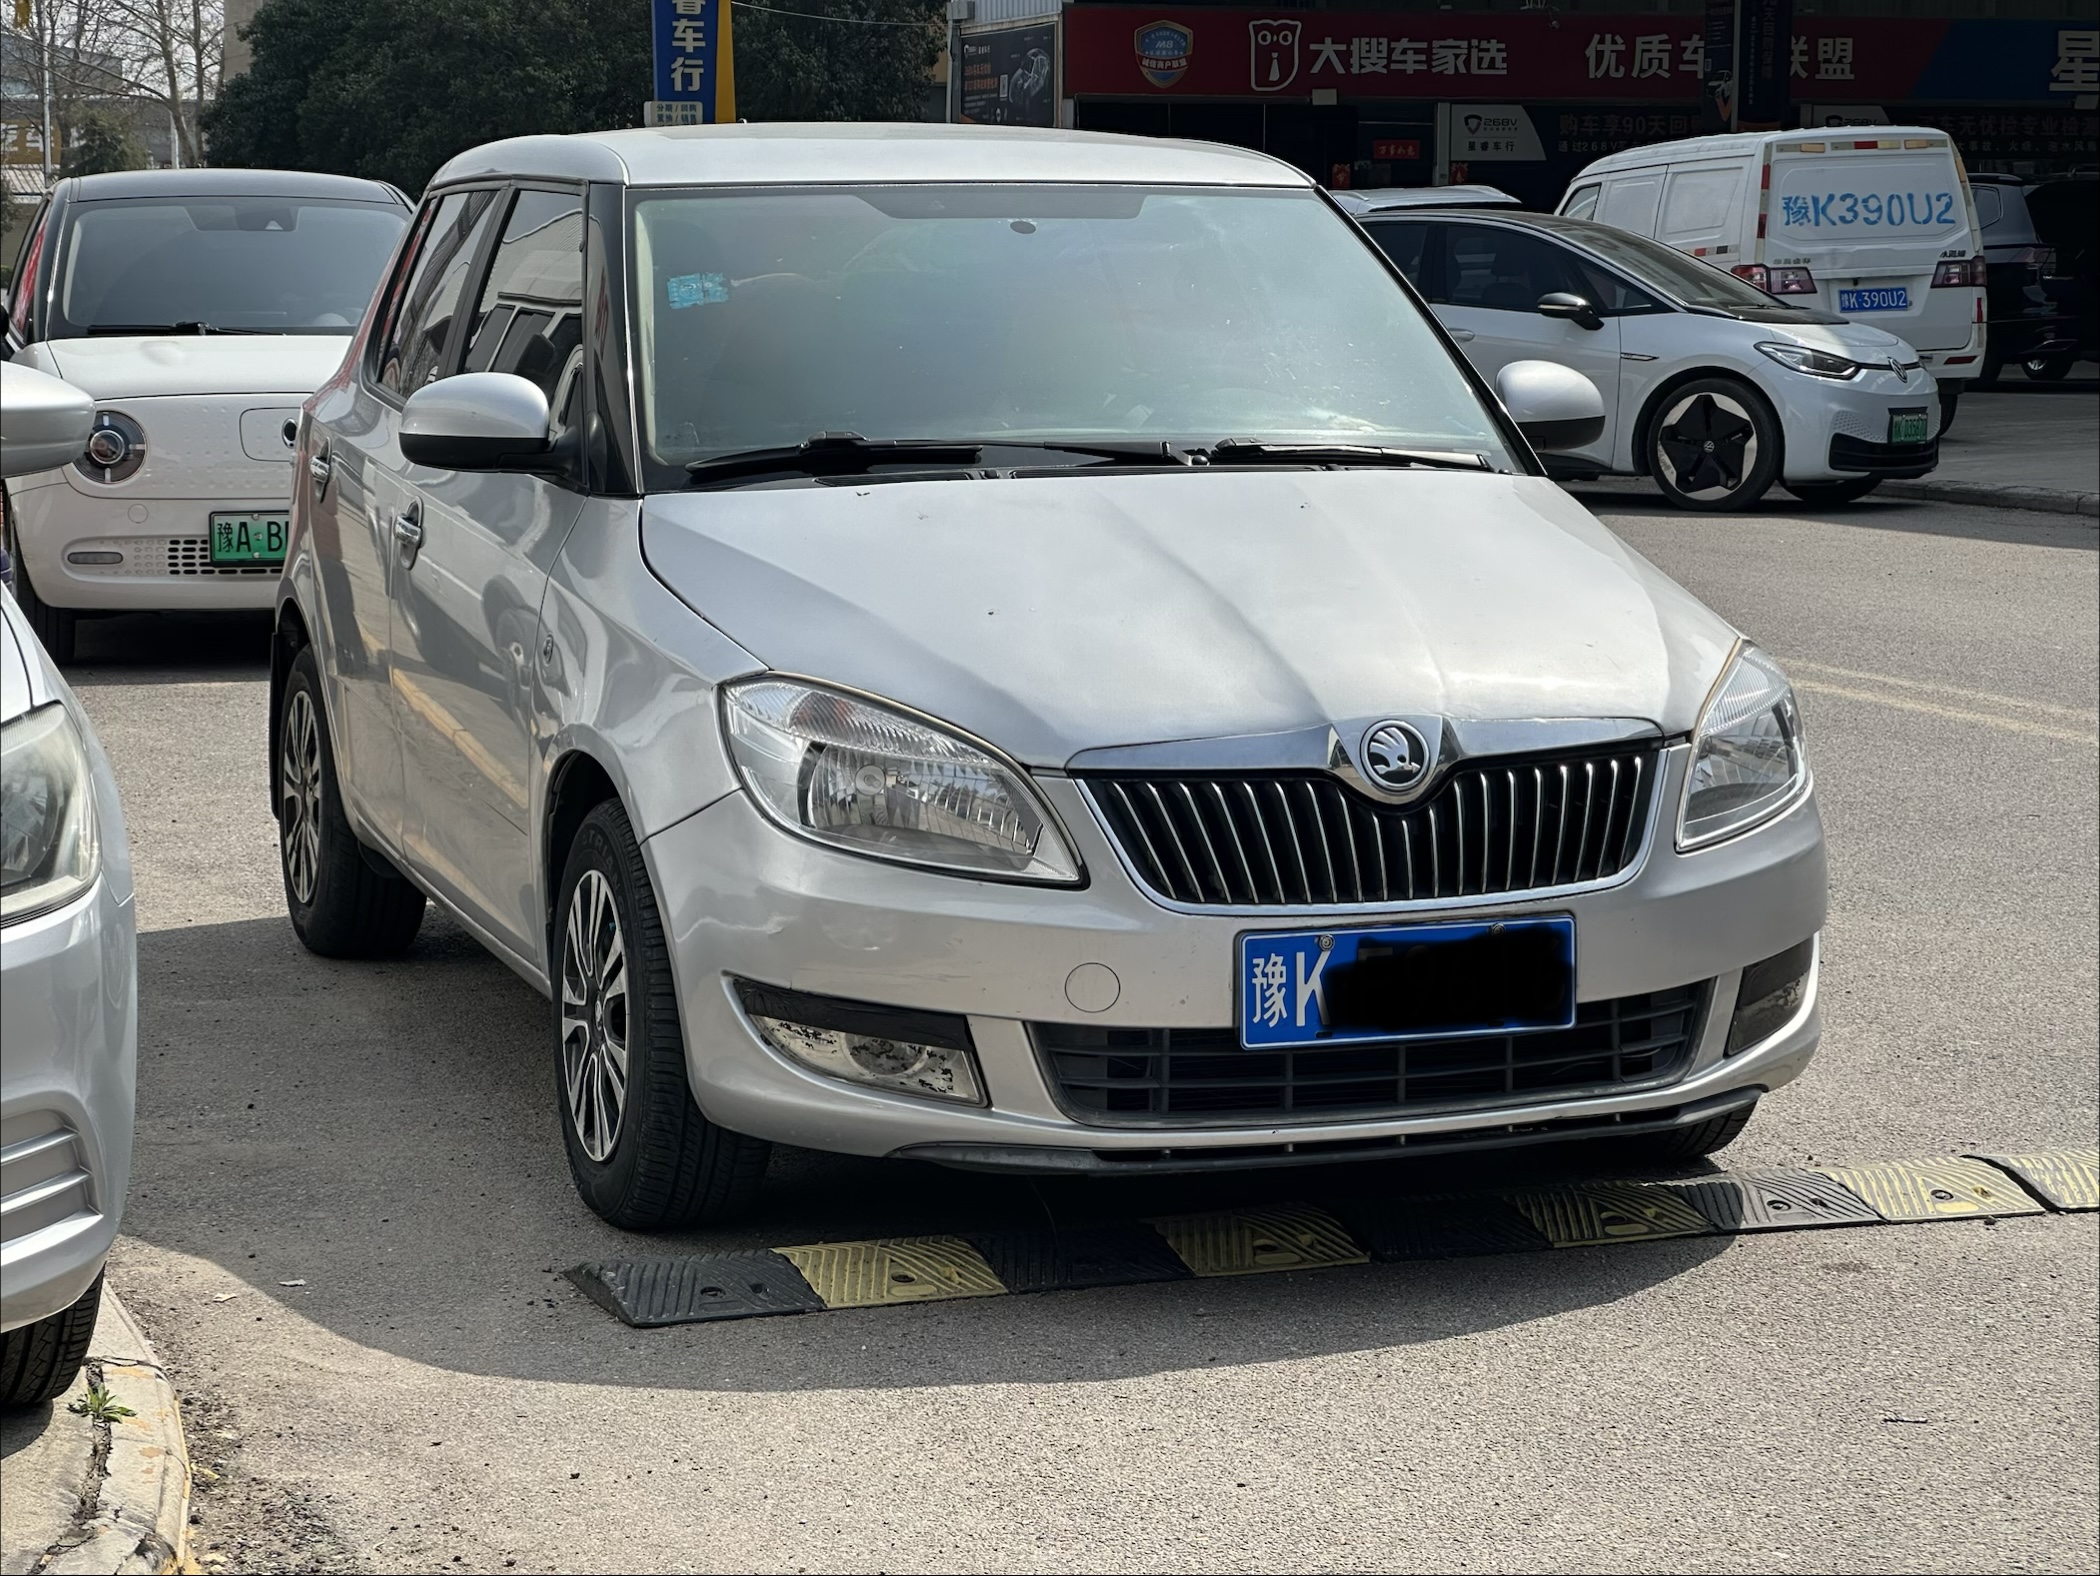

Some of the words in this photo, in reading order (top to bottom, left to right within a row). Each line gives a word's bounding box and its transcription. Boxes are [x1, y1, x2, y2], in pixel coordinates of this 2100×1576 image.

[1309, 37, 1508, 76] 大搜车家选
[1782, 193, 1956, 226] 豫K390U2
